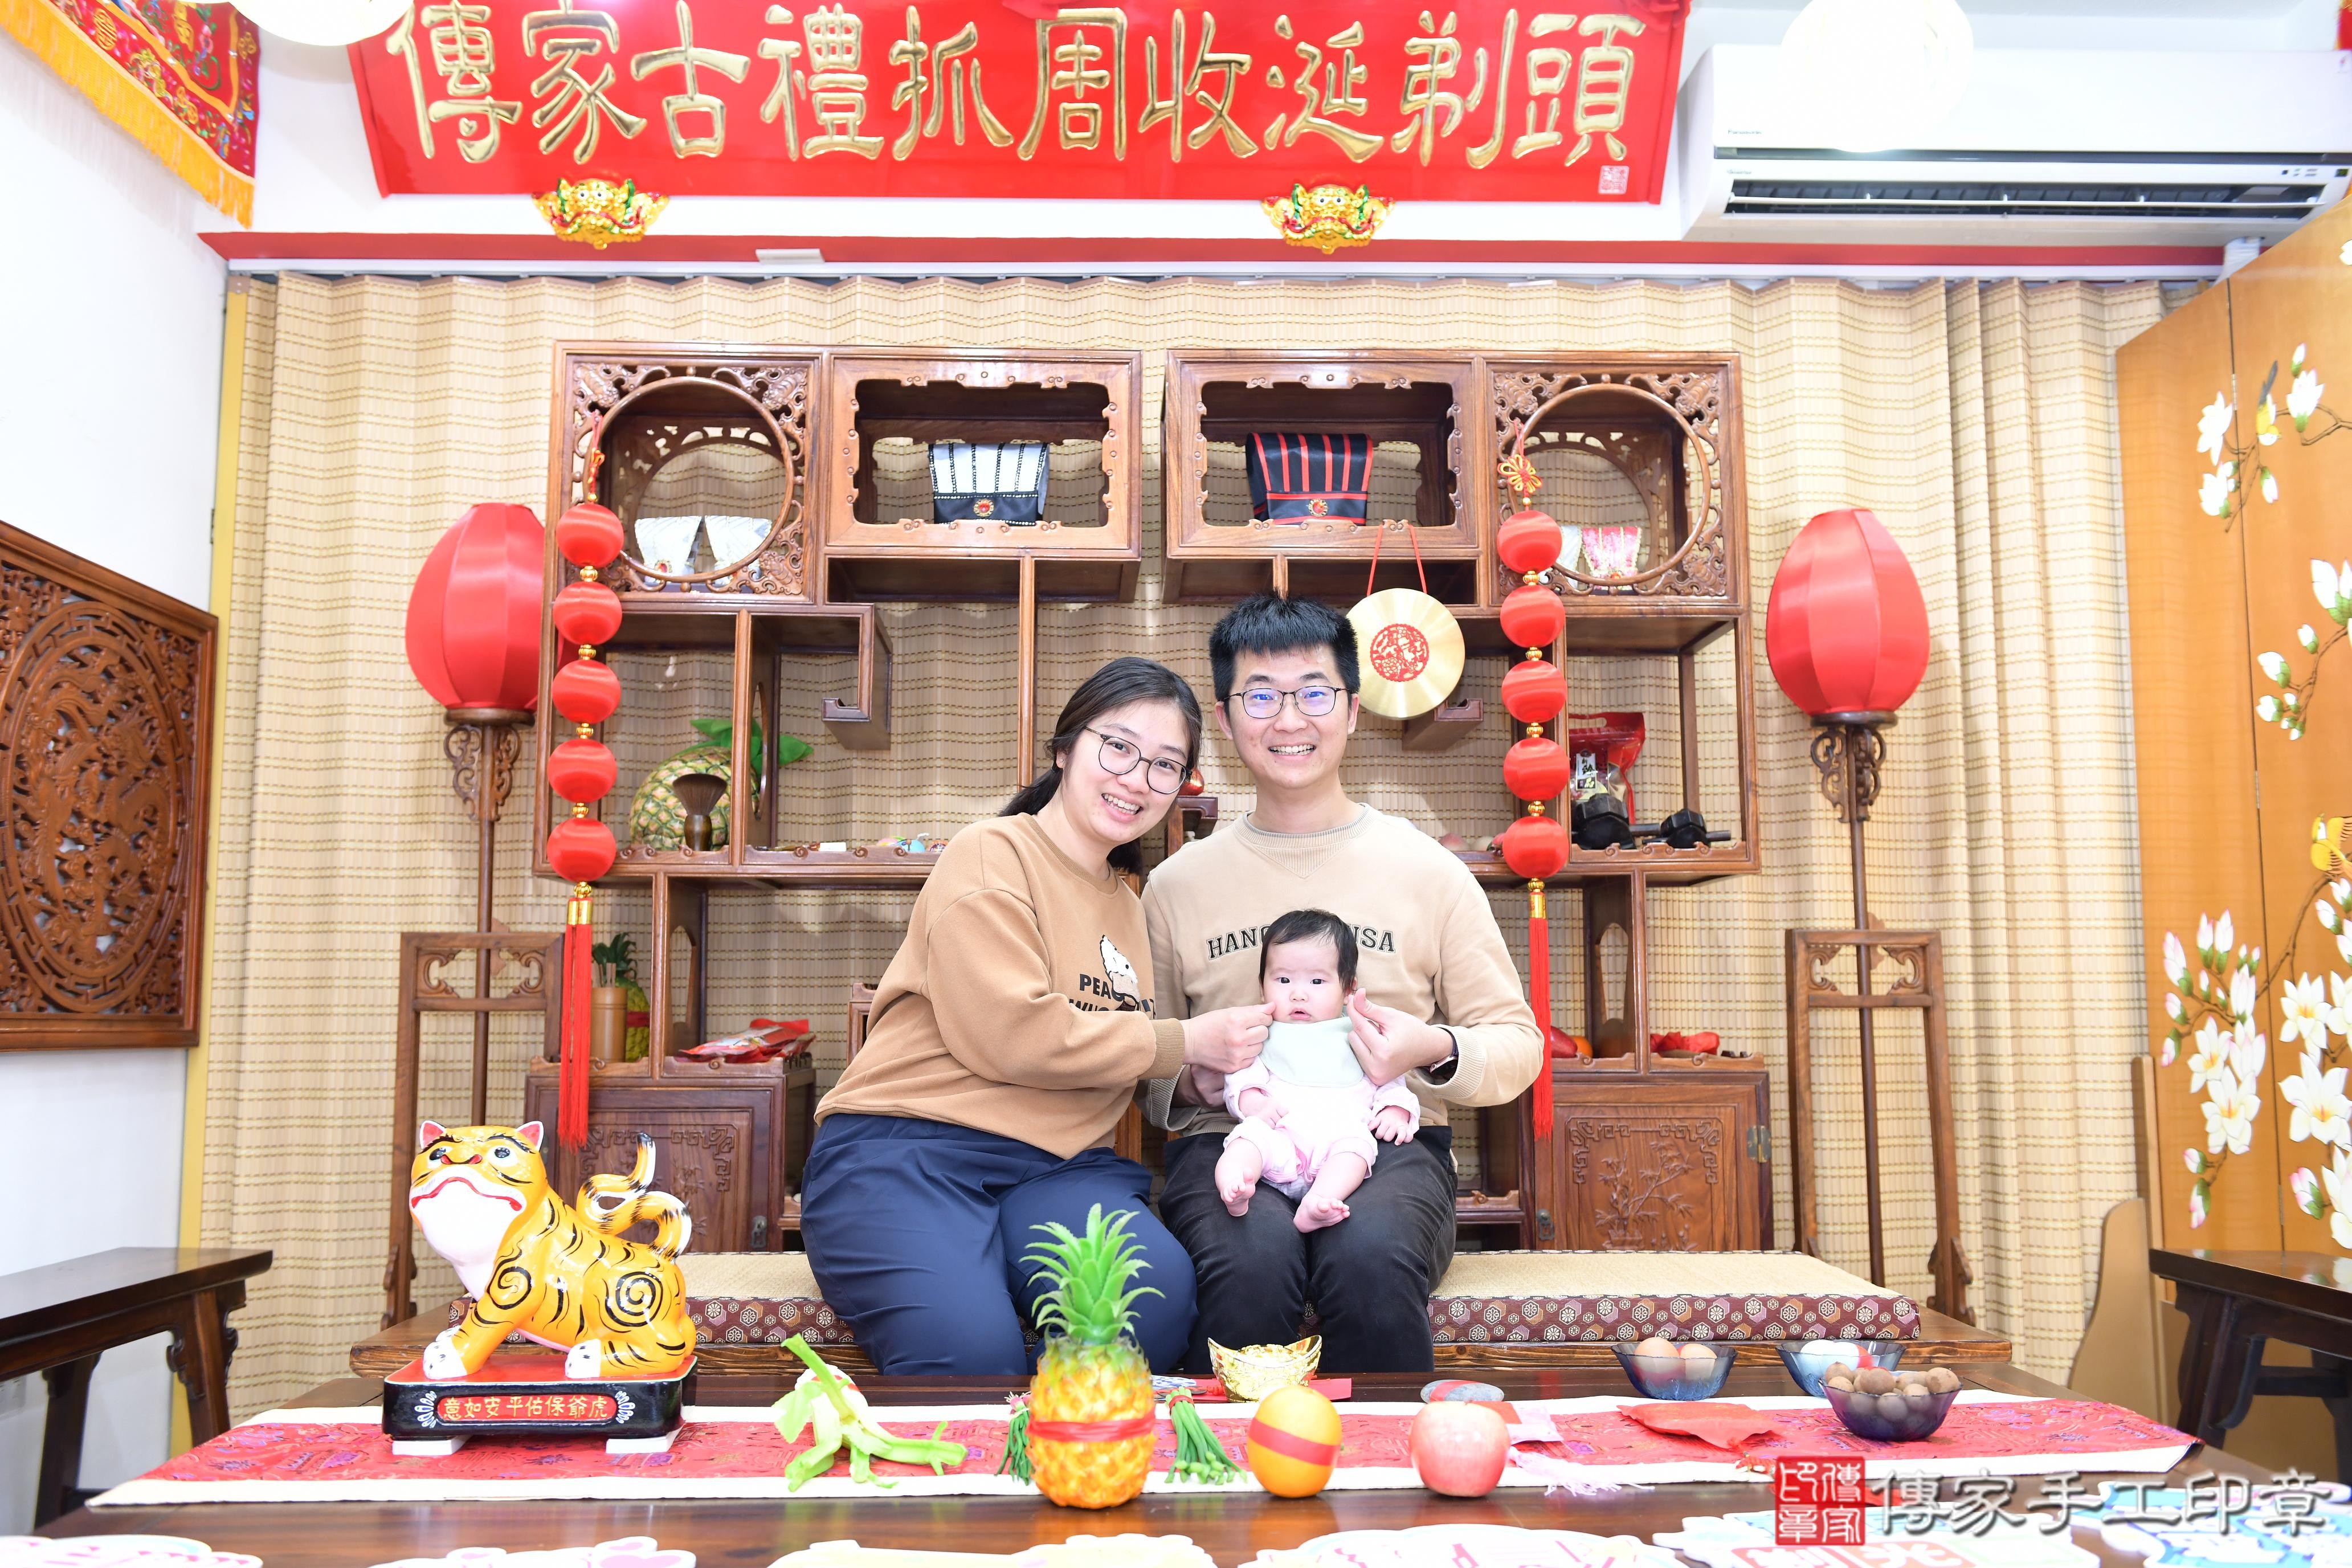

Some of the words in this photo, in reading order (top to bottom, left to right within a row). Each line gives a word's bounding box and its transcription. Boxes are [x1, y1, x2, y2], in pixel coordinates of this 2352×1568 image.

[387, 0, 1646, 169] 傳家古禮抓周收涎剃頭
